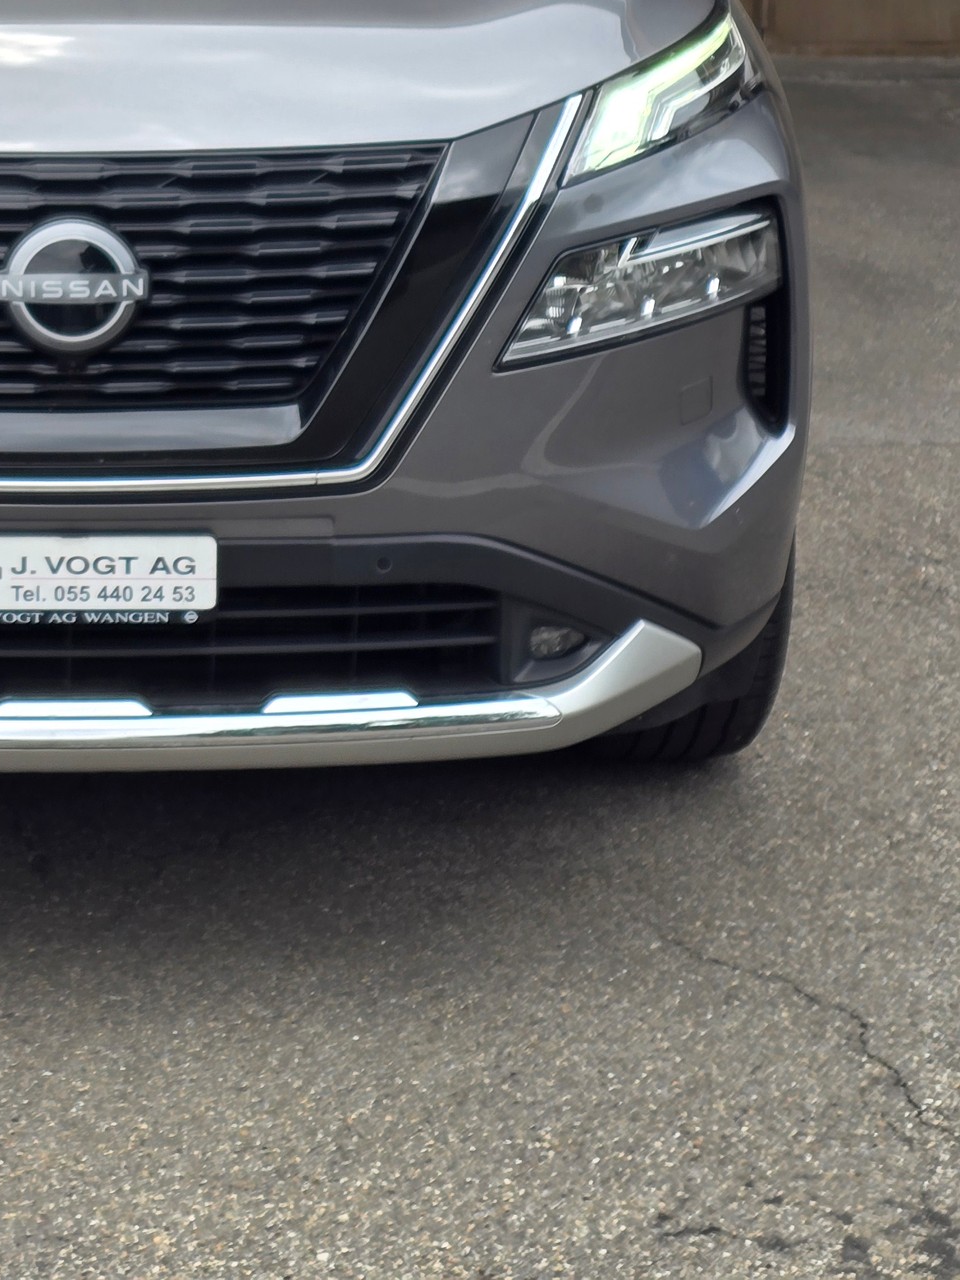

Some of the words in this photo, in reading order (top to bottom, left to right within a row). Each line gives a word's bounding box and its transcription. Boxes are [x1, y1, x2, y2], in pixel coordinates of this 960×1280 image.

[0, 277, 144, 299] NISSAN
[10, 556, 37, 575] J.
[44, 556, 139, 575] VOGT
[149, 556, 197, 575] AG
[10, 585, 47, 602] Tel.
[54, 585, 91, 602] 055
[96, 585, 134, 602] 440
[140, 585, 165, 602] 24
[172, 585, 196, 602] 53
[48, 611, 77, 624] AG
[83, 611, 170, 624] WANGEN
